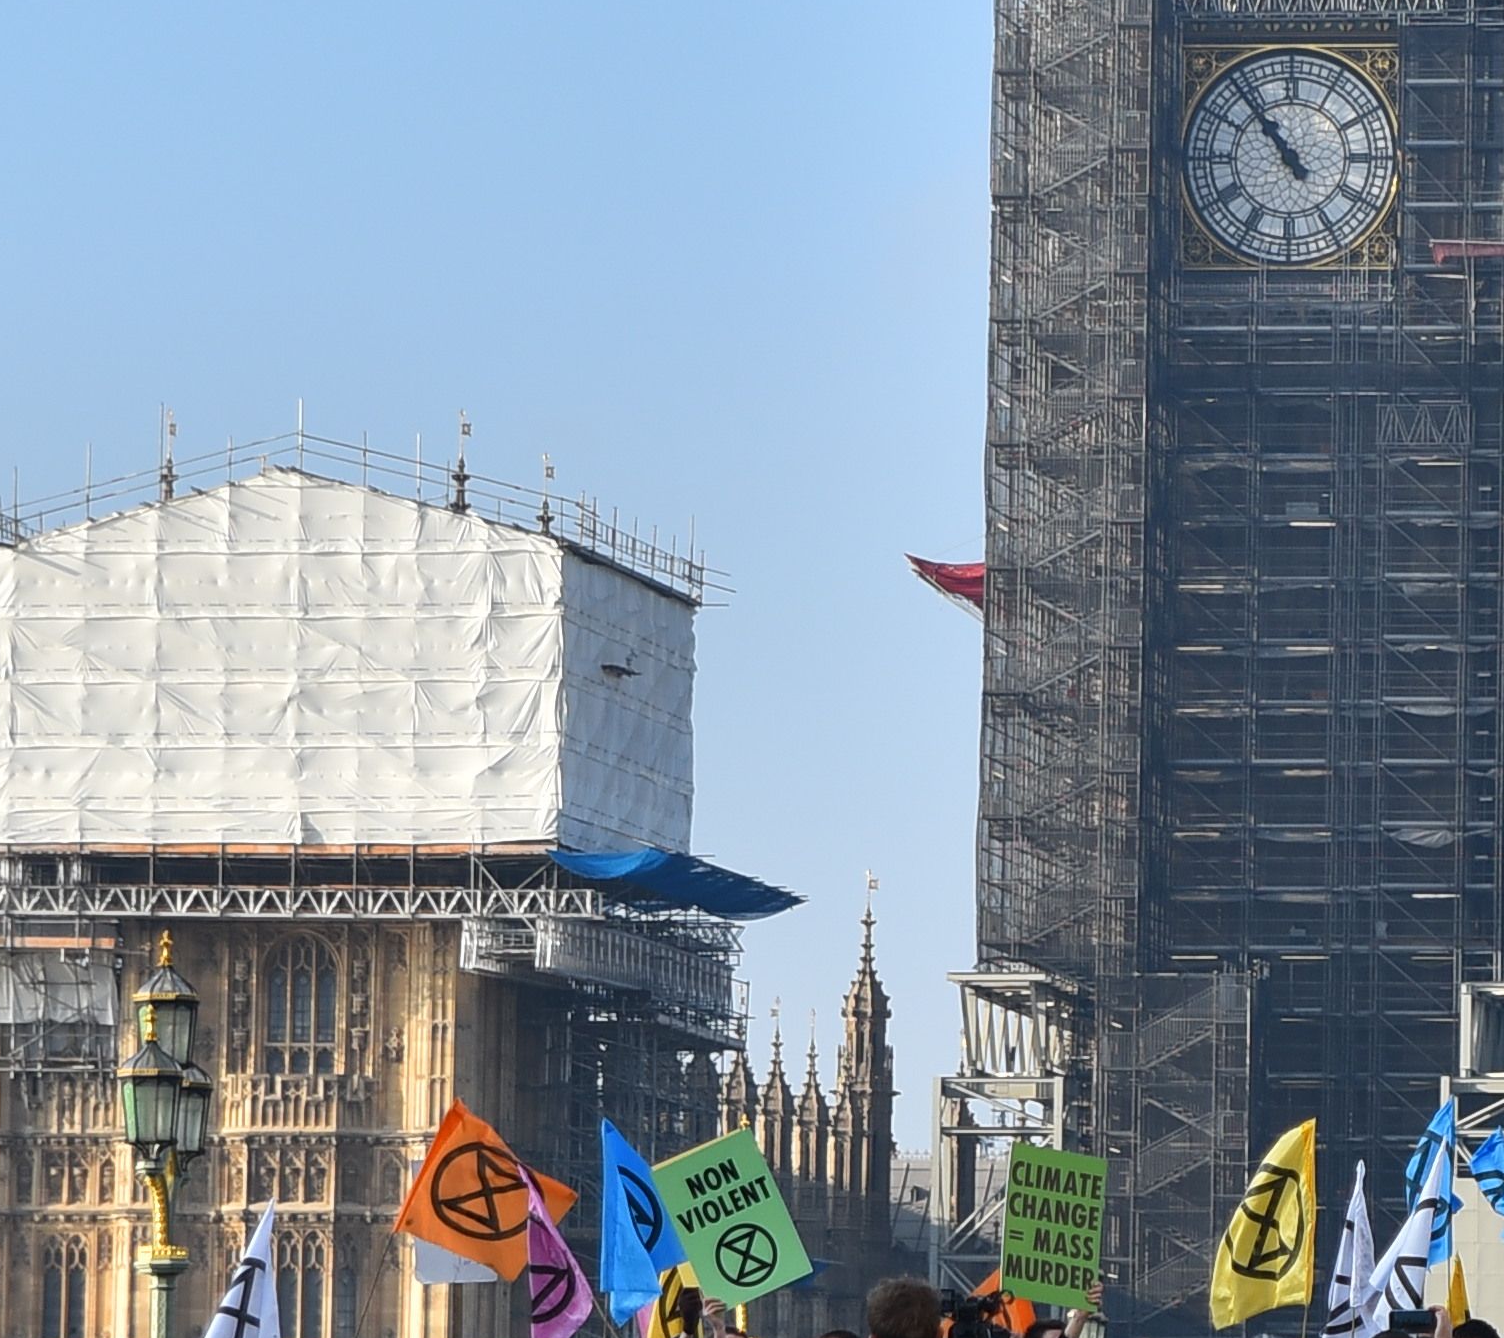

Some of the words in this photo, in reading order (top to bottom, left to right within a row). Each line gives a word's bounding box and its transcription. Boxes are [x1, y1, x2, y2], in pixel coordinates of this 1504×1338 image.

[685, 1158, 740, 1199] NON
[1012, 1160, 1103, 1200] CLIMATE
[676, 1175, 771, 1235] VIOLENT
[1009, 1192, 1100, 1231] CHANGE
[1033, 1228, 1094, 1261] MASS
[1005, 1253, 1095, 1291] MURDER
